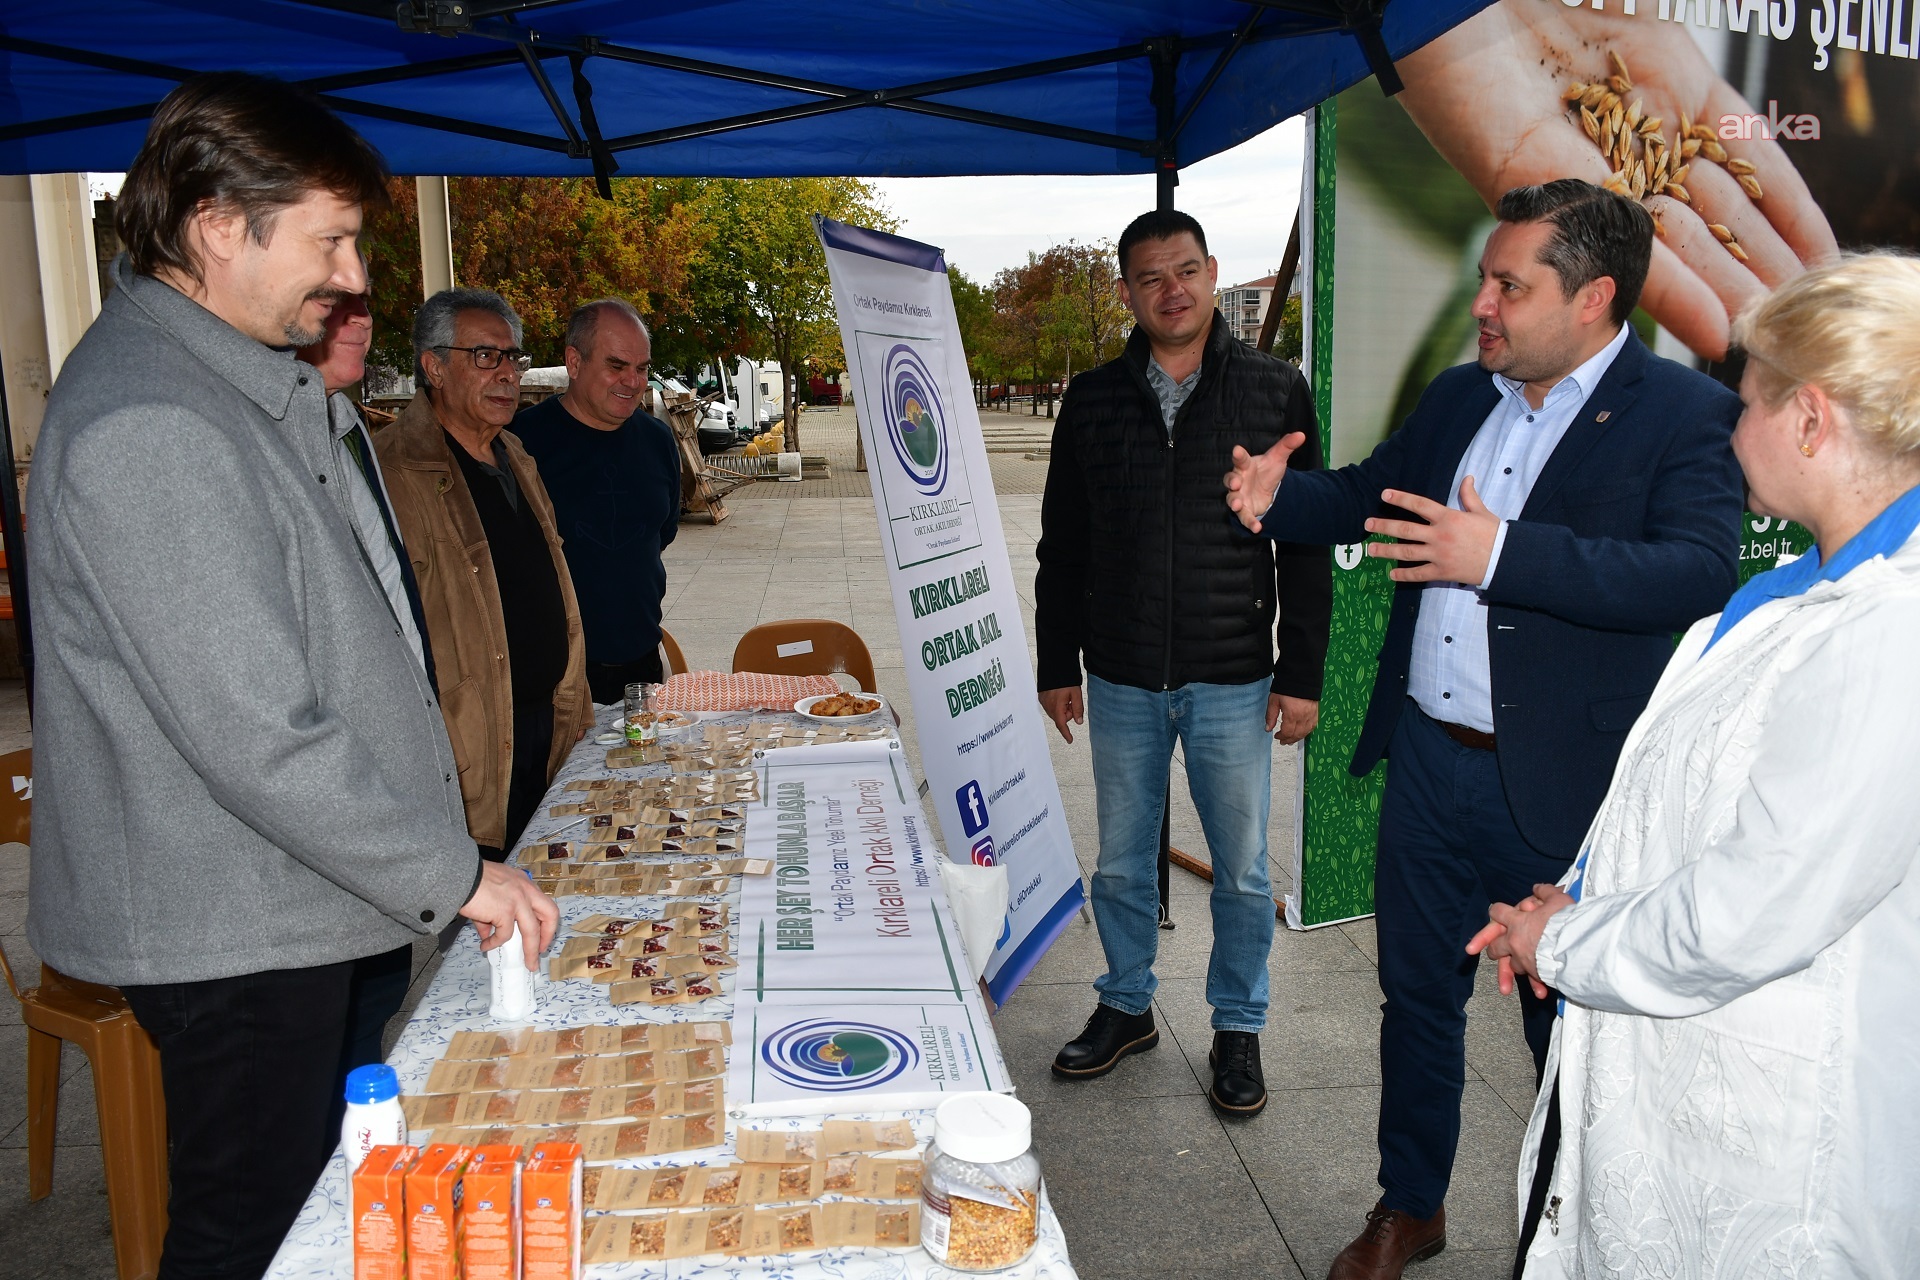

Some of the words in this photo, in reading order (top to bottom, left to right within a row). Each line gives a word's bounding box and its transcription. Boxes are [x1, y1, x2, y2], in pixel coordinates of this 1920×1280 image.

[853, 294, 873, 309] Ortak
[909, 496, 960, 521] KIRKLARELİ
[914, 523, 935, 537] ORTAK
[909, 560, 990, 619] KIRKLARELİ
[921, 623, 980, 671] ORTAK
[977, 612, 1002, 648] AKIL
[945, 657, 1006, 718] DERNEĞİ
[777, 781, 816, 821] BAŞLAR
[851, 779, 885, 815] Derneği
[857, 816, 889, 835] Akıl
[776, 822, 810, 887] TOHUMLA
[829, 848, 856, 891] Paydamız
[862, 836, 897, 876] Ortak
[776, 888, 825, 915] ŞEY
[868, 879, 912, 938] Kırklareli
[776, 917, 814, 950] HER
[916, 1025, 945, 1081] KIRKLARELİ
[945, 1049, 956, 1062] AKIL
[948, 1062, 961, 1081] ORTAK
